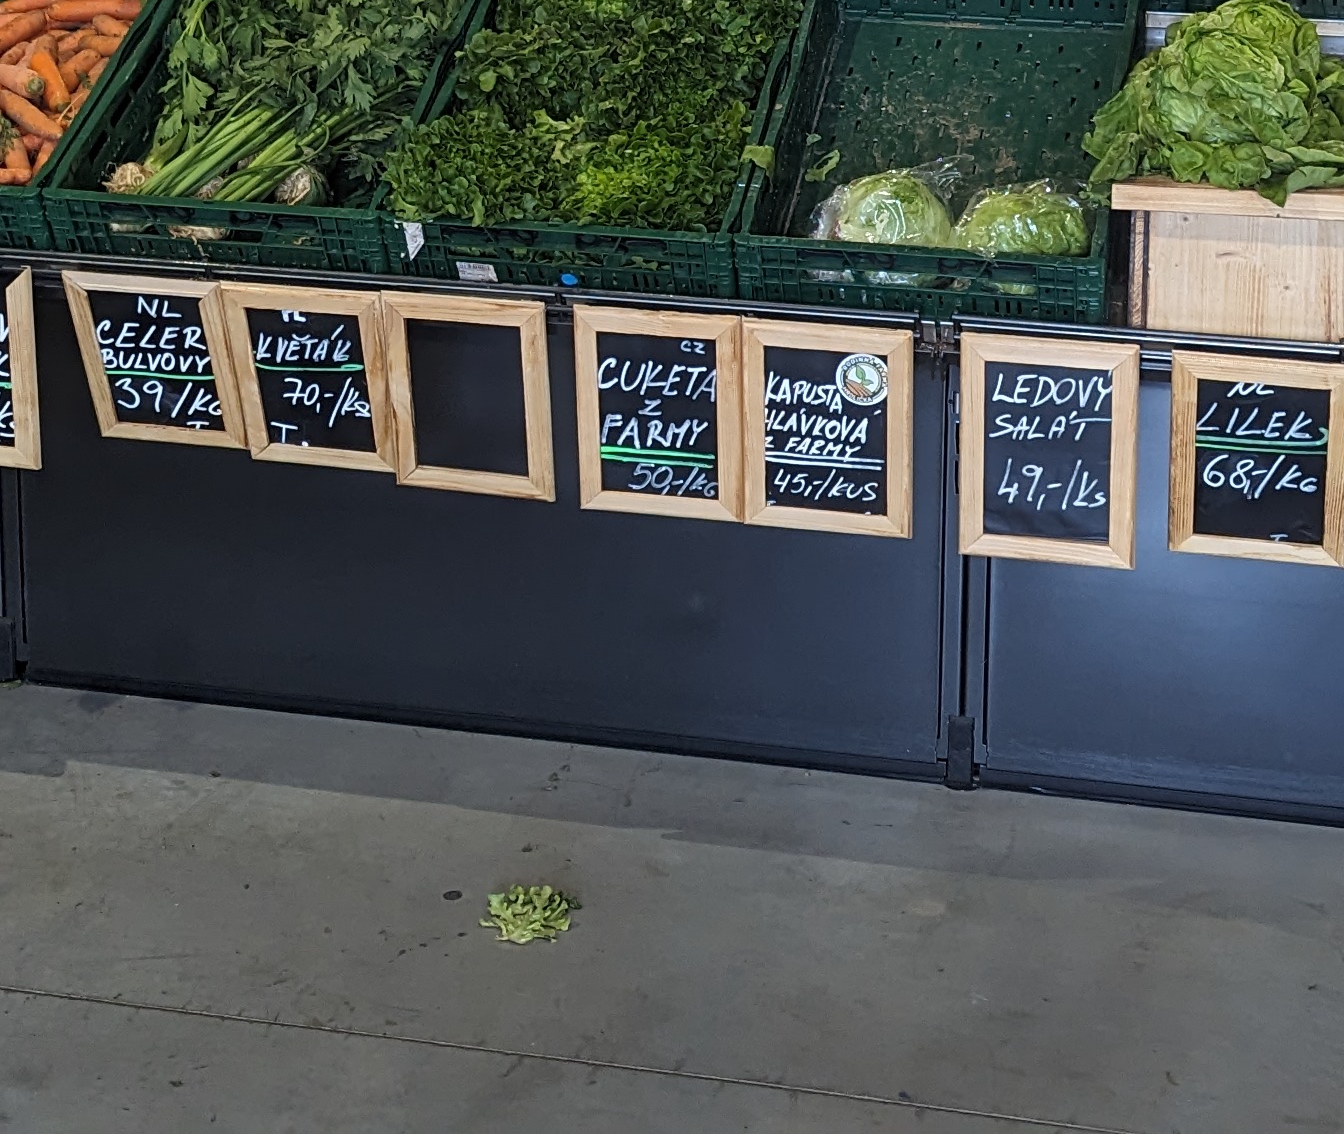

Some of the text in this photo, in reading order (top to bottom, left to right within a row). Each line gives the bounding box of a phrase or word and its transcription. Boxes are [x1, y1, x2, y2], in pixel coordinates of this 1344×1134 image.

[136, 295, 183, 319] NL
[96, 319, 207, 351] CELER
[256, 324, 352, 364] KVĚTÁK
[680, 340, 706, 355] CZ
[102, 347, 211, 373] BULVOVY
[598, 357, 717, 403] CUKETA
[765, 371, 843, 414] KAPUSTA
[991, 369, 1114, 408] LEDOVÝ
[646, 398, 662, 417] Z
[1195, 401, 1313, 440] LILEK
[601, 413, 710, 449] FARMY
[988, 410, 1112, 442] SALÁT
[784, 437, 861, 462] FARMY
